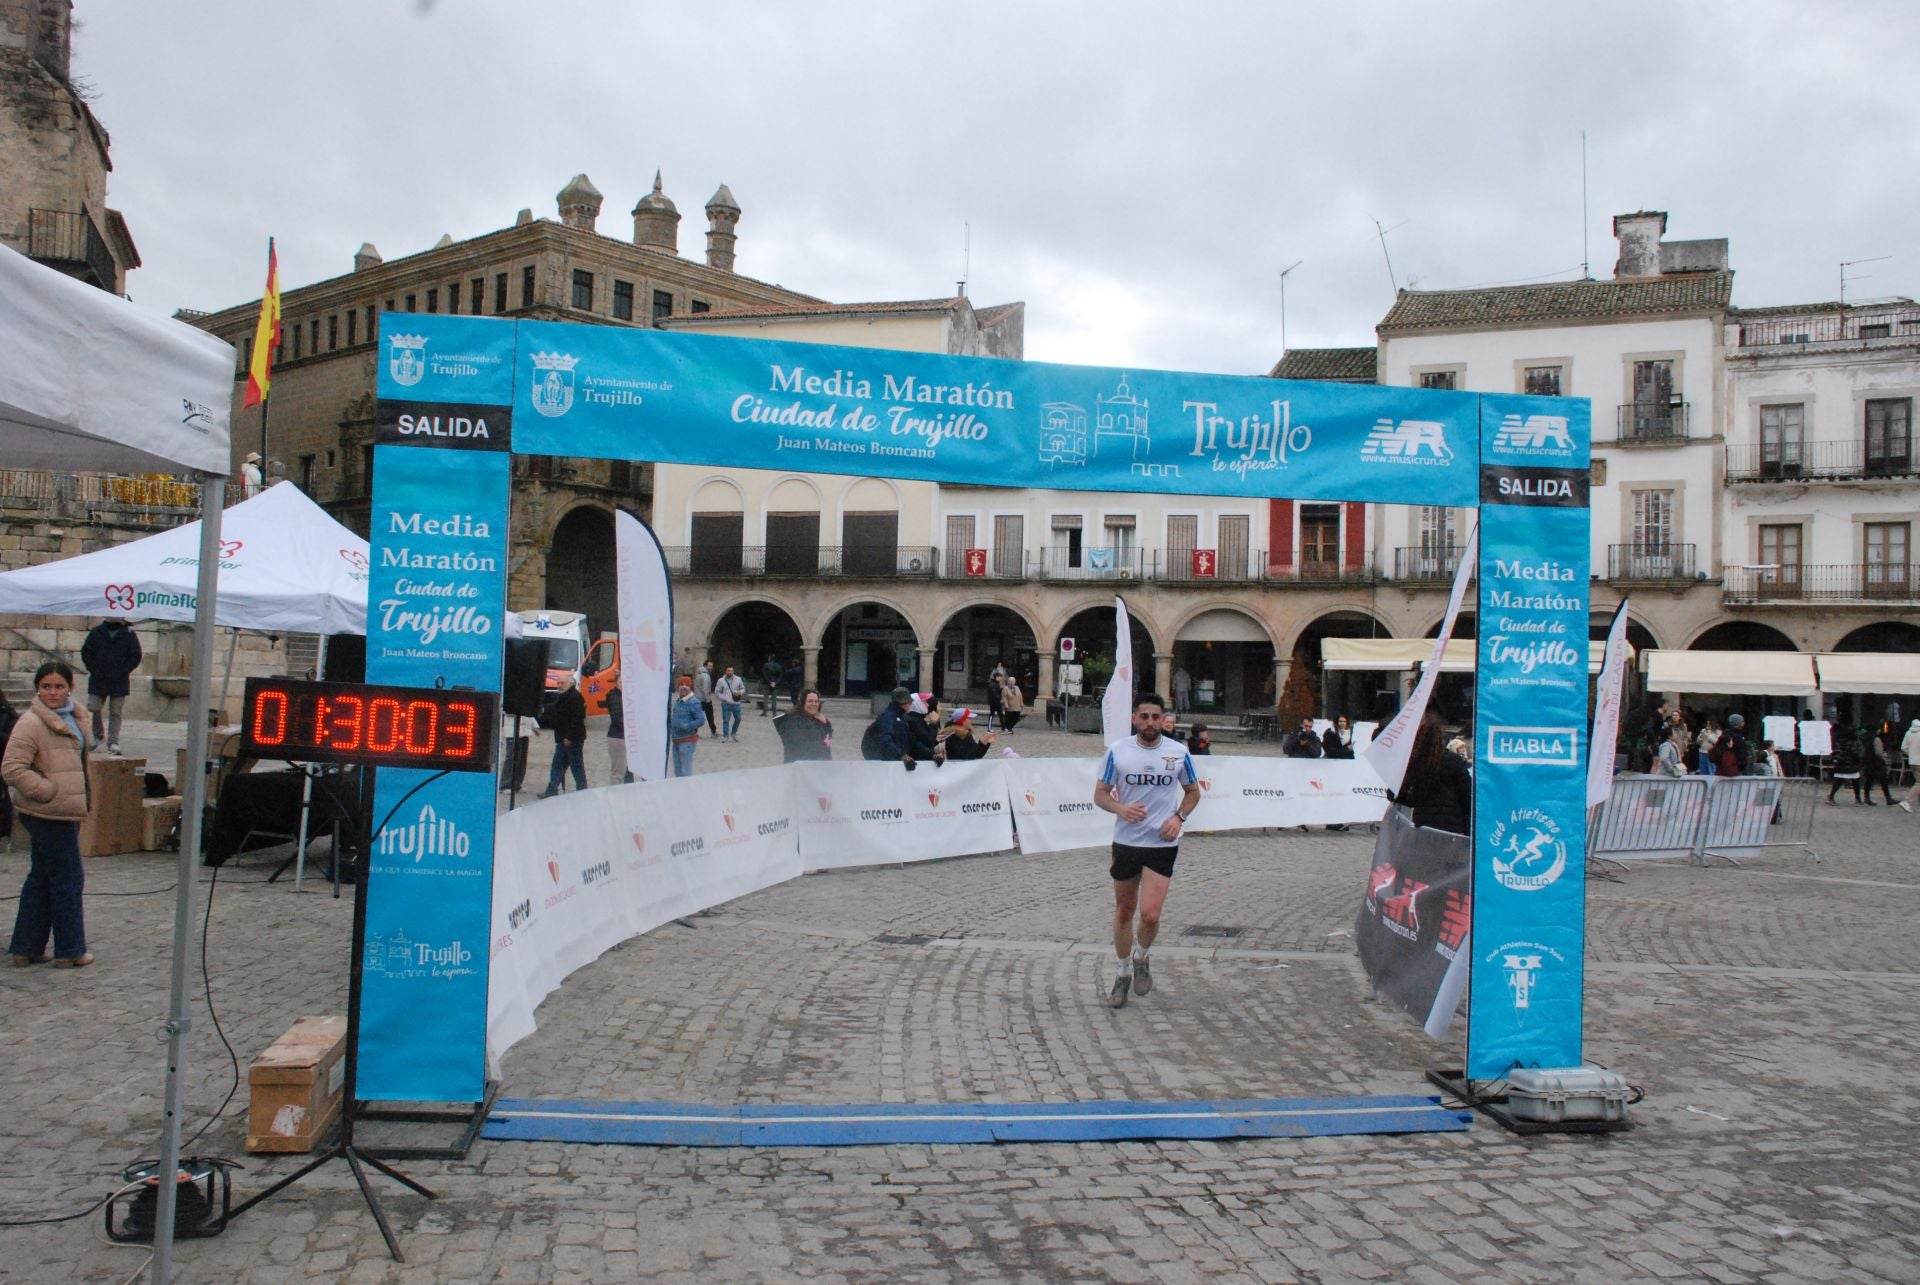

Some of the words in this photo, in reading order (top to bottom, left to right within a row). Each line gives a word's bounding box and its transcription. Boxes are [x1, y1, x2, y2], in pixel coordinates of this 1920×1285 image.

[432, 352, 490, 364] Ayuntamiento
[430, 362, 478, 378] Trujillo
[584, 375, 658, 391] Ayuntamiento
[659, 381, 673, 391] de
[769, 364, 873, 399] Media
[881, 374, 1016, 410] Maratón
[582, 388, 642, 408] Trujillo
[397, 414, 489, 439] SALIDA
[730, 394, 838, 429] Ciudad
[841, 406, 881, 432] de
[887, 404, 990, 448] Trujillo
[1182, 399, 1312, 463] Trujillo
[776, 434, 811, 450] Juan
[814, 437, 866, 454] Mateos
[870, 442, 936, 459] Broncano
[1492, 445, 1573, 457] www.musicrun.es
[1212, 451, 1227, 472] te
[1360, 454, 1451, 467] www.musicrun.es
[1498, 477, 1573, 497] SALIDA
[388, 511, 491, 538] Media
[380, 547, 497, 572] Maratón
[1493, 559, 1576, 581] Media
[394, 578, 455, 598] Ciudad
[456, 583, 479, 599] de
[1489, 590, 1582, 611] Maratón
[379, 599, 492, 645] Trujillo
[1499, 616, 1548, 633] Ciudad
[1548, 620, 1567, 634] de
[381, 647, 404, 658] Juan
[406, 648, 441, 659] Mateos
[442, 650, 488, 660] Broncano
[1487, 634, 1579, 674] Trujillo
[1499, 738, 1564, 755] HABLA
[1125, 773, 1173, 786] CIRIO
[1489, 820, 1506, 847] Club
[1511, 807, 1560, 833] Atletismo
[1498, 871, 1550, 887] TRUJILLO
[414, 940, 471, 966] Trujillo
[1519, 986, 1526, 1000] S
